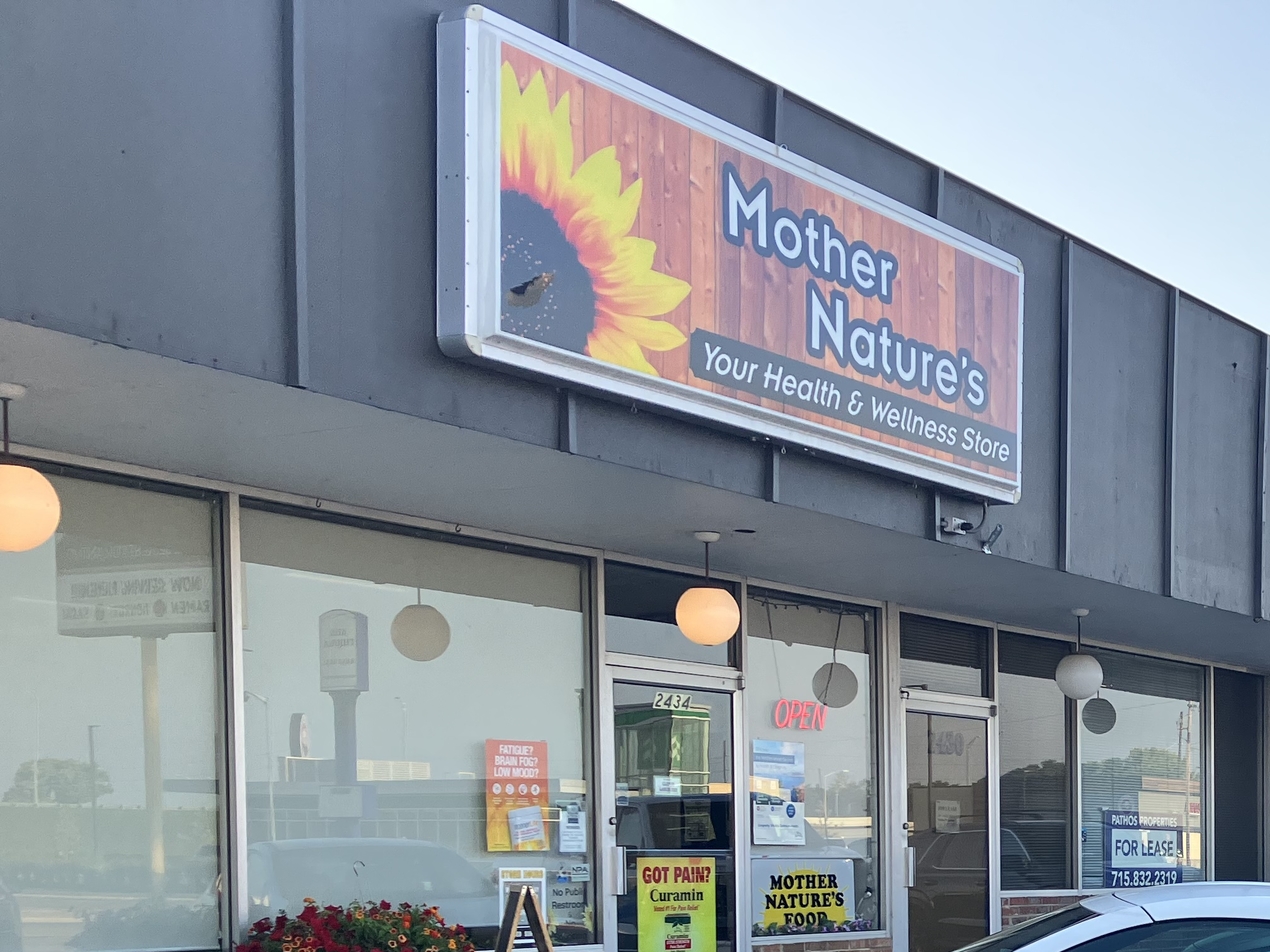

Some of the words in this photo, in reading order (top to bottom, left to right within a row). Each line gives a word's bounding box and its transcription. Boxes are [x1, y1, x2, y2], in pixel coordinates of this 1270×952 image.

[727, 171, 894, 296] Mother
[810, 288, 986, 407] Nature's
[703, 341, 758, 384] Your
[763, 361, 840, 411] Health
[847, 389, 864, 416] &
[871, 395, 957, 448] Wellness
[960, 427, 1011, 464] Store
[655, 693, 691, 709] 2434
[775, 697, 828, 731] OPEN
[499, 744, 534, 756] FATIGUE?
[494, 755, 517, 767] BRAIN
[519, 757, 538, 768] FOG?
[493, 766, 511, 777] LOW
[512, 767, 539, 778] MOOD?
[1111, 814, 1138, 826] PATHOS
[1139, 815, 1177, 828] PROPERTIES
[1115, 839, 1138, 857] FOR
[1141, 839, 1174, 857] LEASE
[642, 866, 670, 884] GOT
[673, 866, 711, 884] PAIN?
[769, 874, 838, 890] MOTHER
[1111, 870, 1177, 887] 715.832.2319
[552, 888, 563, 897] No
[564, 887, 585, 897] Publi
[650, 888, 704, 902] Curamin
[765, 891, 844, 909] NATURE'S
[783, 911, 828, 927] FOOD
